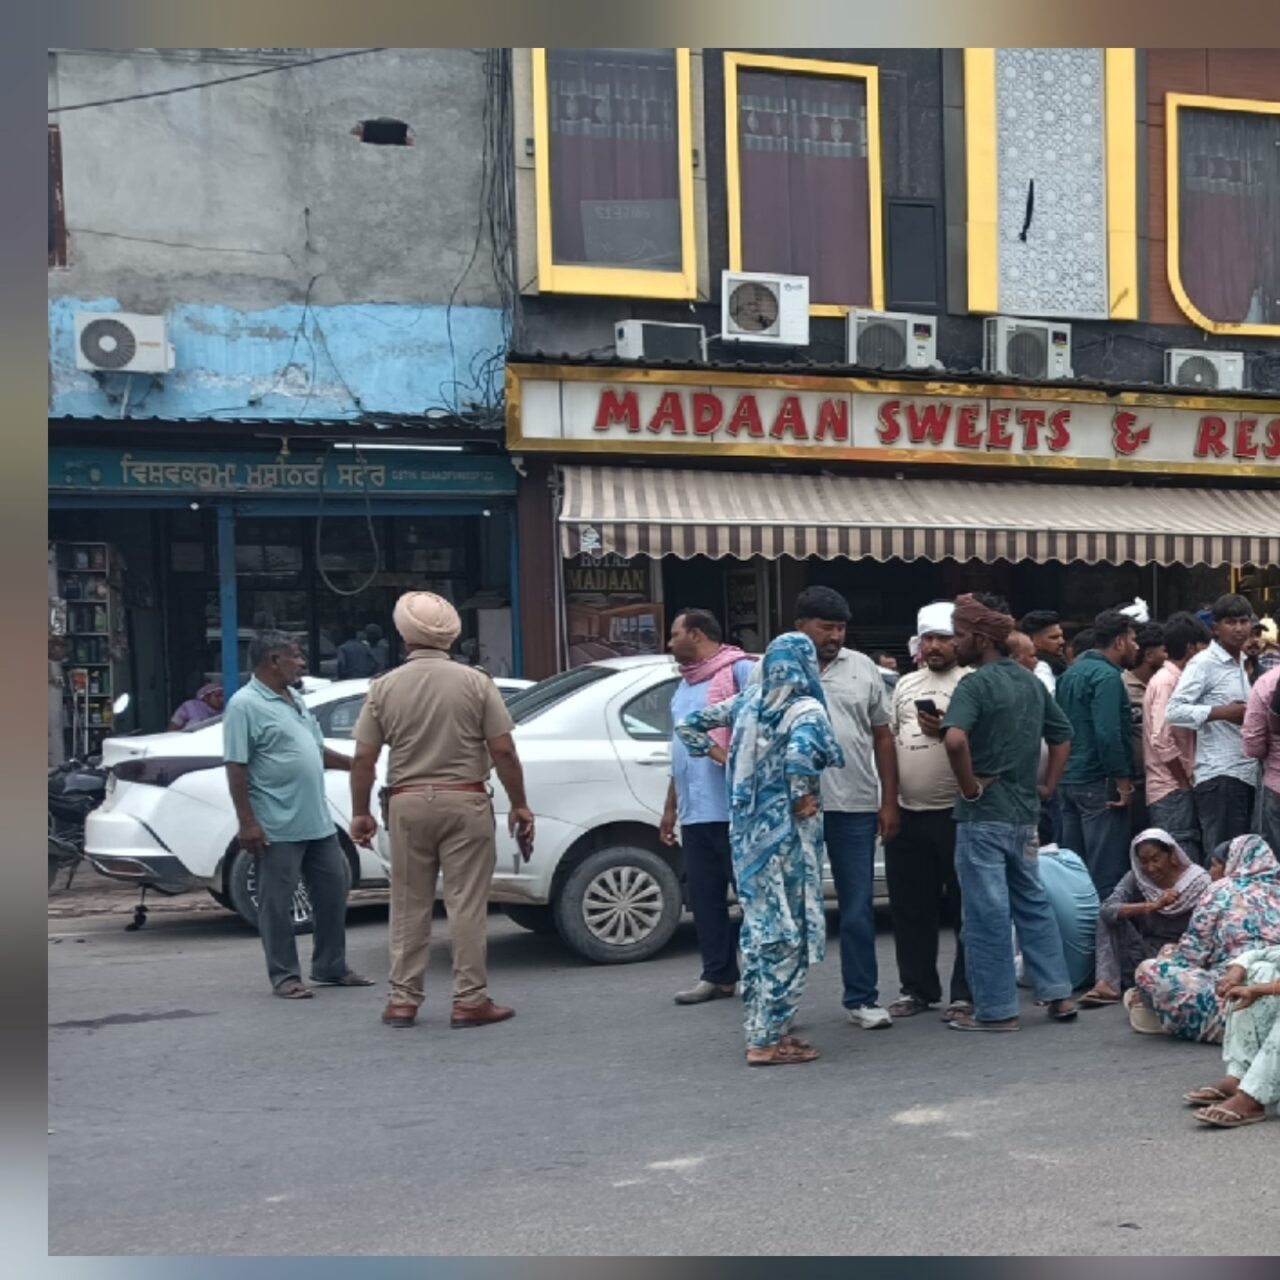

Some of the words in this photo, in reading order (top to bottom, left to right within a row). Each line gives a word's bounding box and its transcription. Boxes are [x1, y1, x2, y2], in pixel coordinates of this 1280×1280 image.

[594, 387, 850, 442] MADAAN
[877, 400, 1071, 451] SWEETS
[1111, 411, 1152, 455] &
[568, 569, 645, 590] MADAAN
